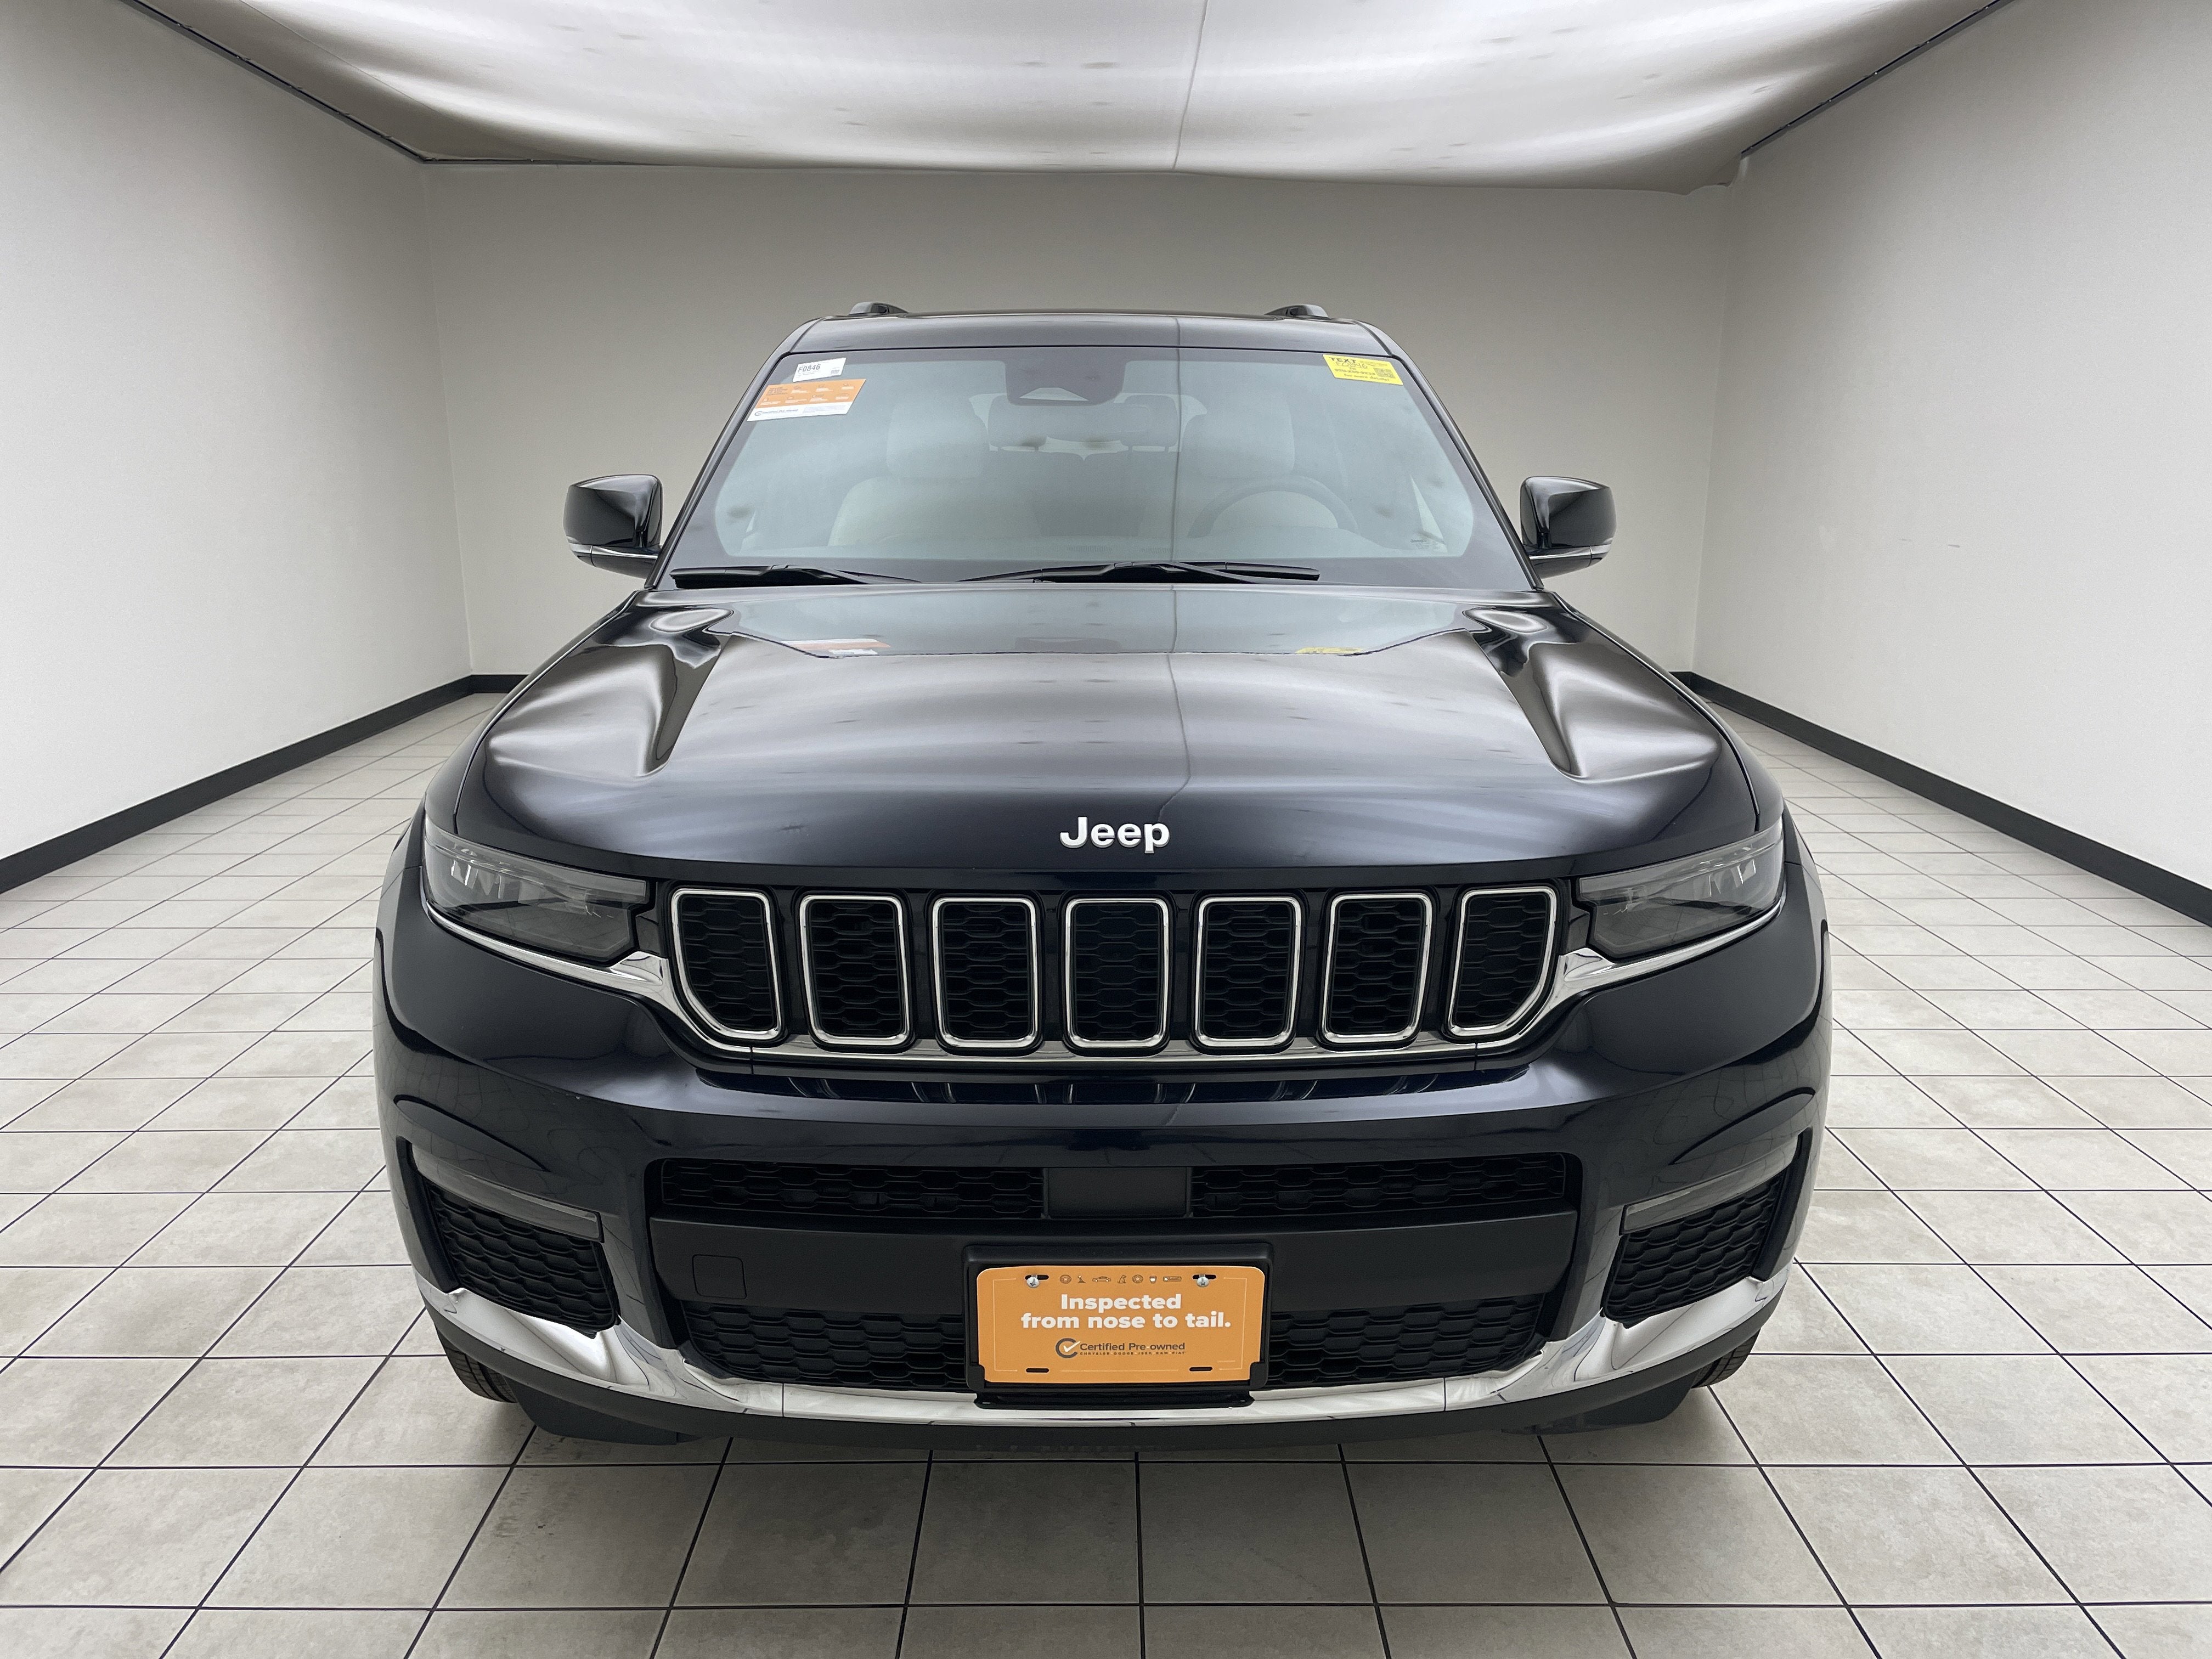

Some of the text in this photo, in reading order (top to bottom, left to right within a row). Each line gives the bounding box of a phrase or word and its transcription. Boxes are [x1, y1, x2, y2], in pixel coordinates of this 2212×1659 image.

[798, 364, 821, 373] F0846
[1059, 816, 1170, 854] Jeep
[1060, 1293, 1181, 1313] Inspected
[1021, 1311, 1231, 1329] from nose to tail.
[1080, 1342, 1185, 1351] Certified Pre-owned
